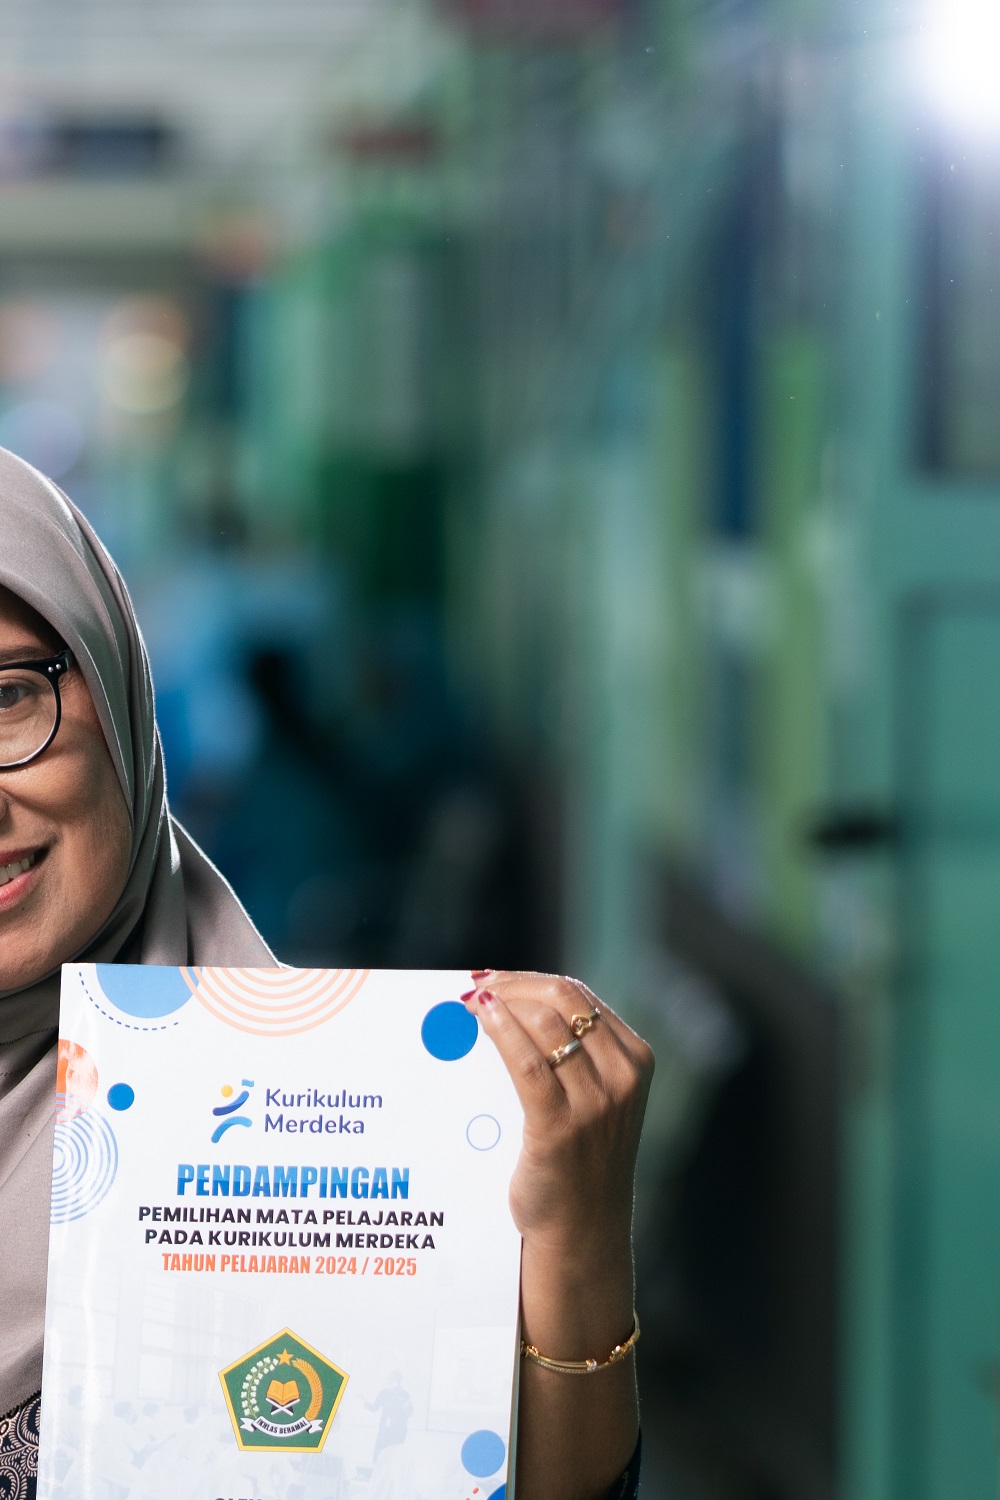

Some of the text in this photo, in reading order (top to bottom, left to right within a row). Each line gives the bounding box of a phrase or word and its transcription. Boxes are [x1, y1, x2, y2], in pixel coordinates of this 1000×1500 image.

[264, 1088, 383, 1109] Kurikulum
[264, 1113, 365, 1134] Merdeka
[176, 1164, 410, 1200] PENDAMPINGAN
[138, 1206, 445, 1227] PEMILIHAN MATA PELAJARAN
[145, 1229, 436, 1250] PADA KURIKULUM MERDEKA
[162, 1253, 417, 1276] TAHUN PELAJARAN 2024 / 2025
[256, 1419, 308, 1434] IKHLAS BERAMAL
